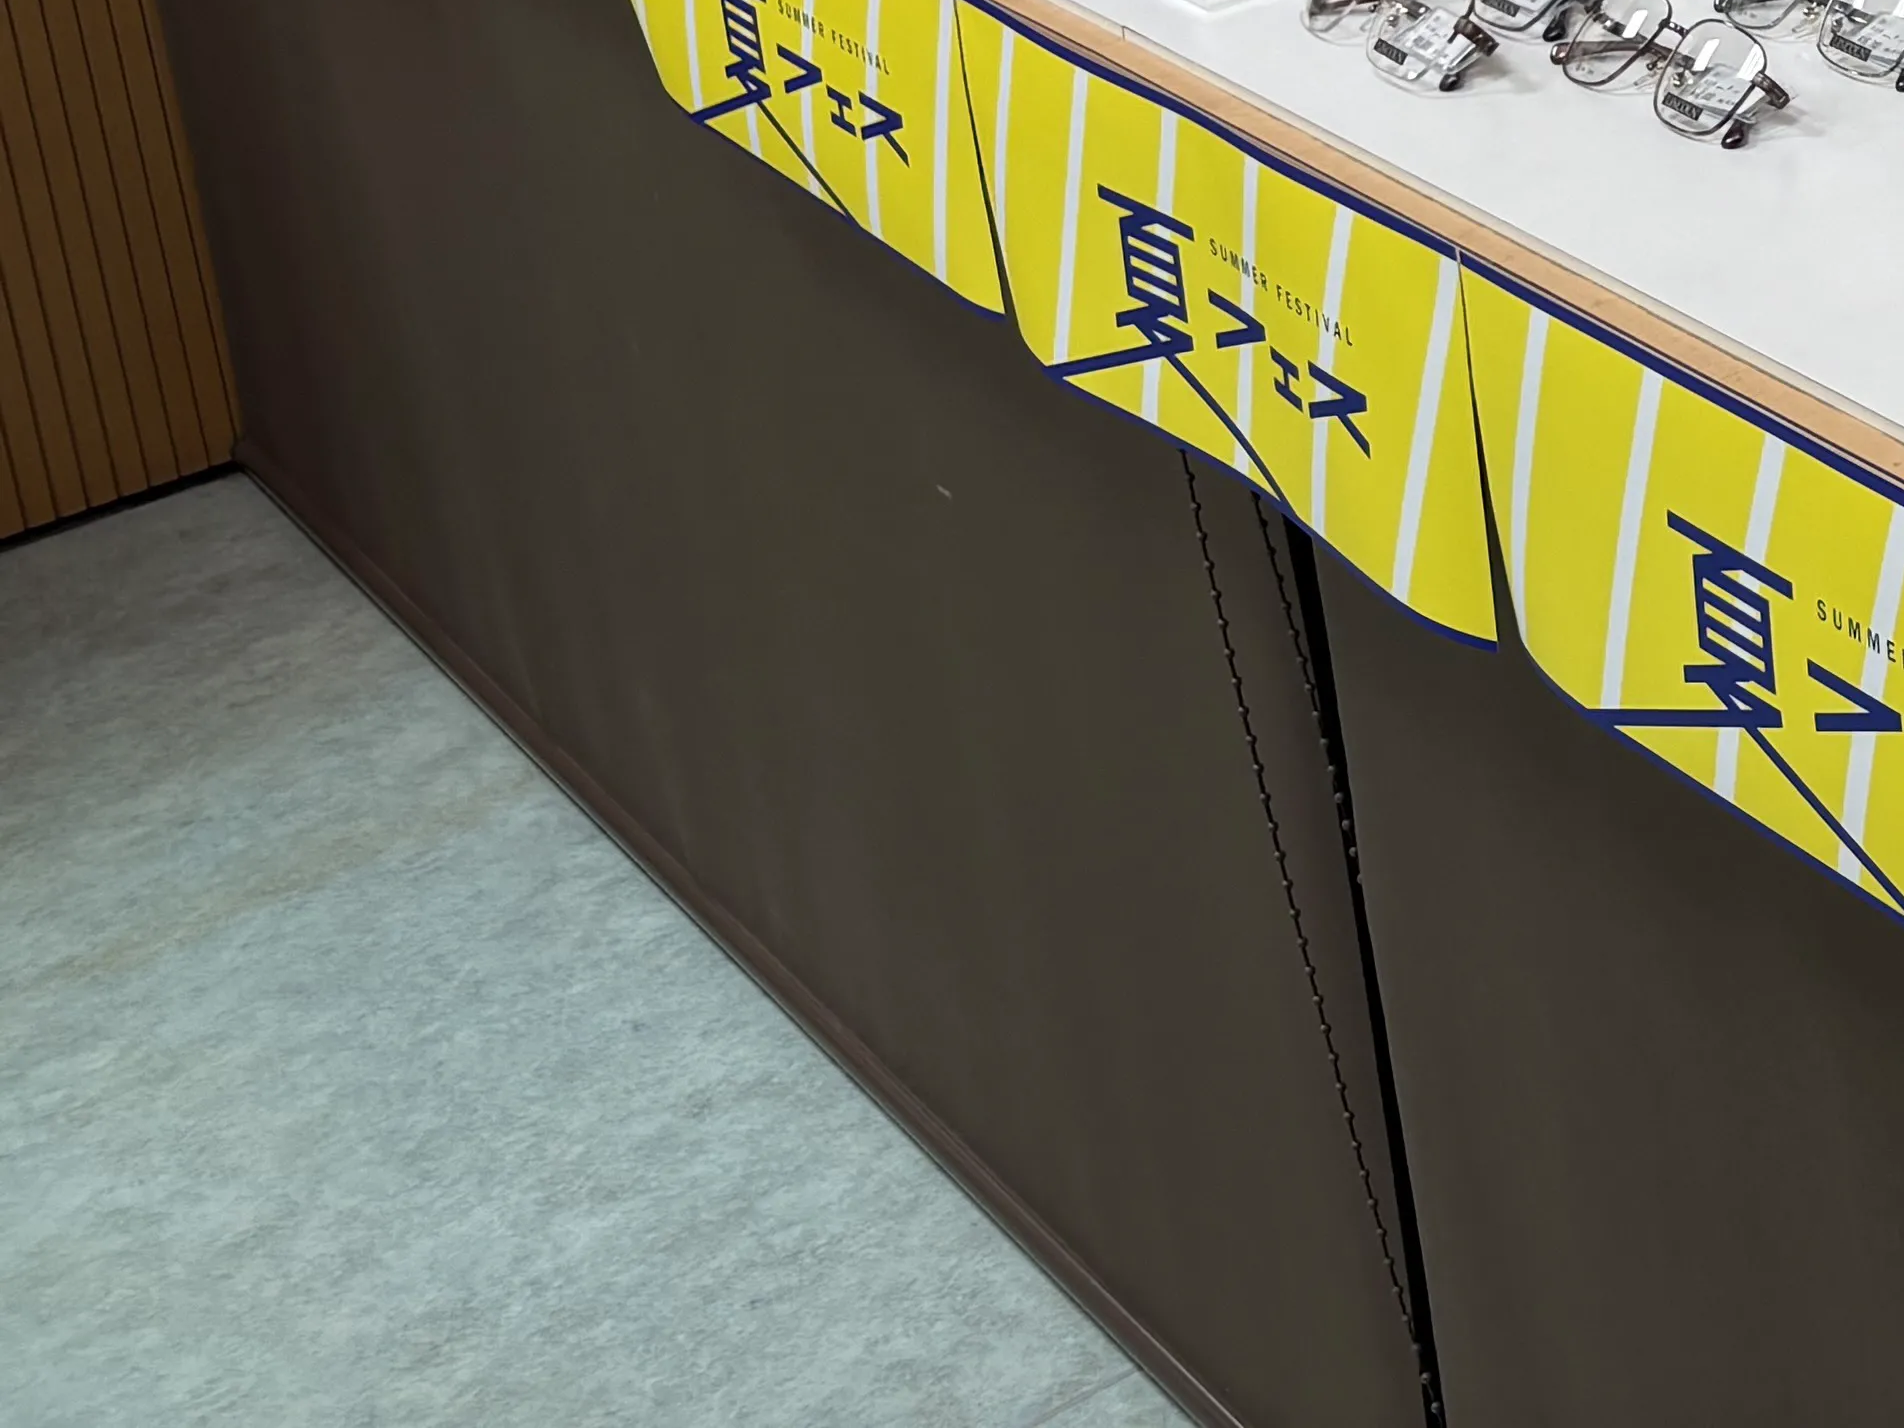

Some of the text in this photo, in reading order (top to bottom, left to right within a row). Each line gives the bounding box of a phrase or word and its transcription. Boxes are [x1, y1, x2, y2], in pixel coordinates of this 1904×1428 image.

[831, 27, 890, 77] FESTIVAL
[1208, 237, 1354, 348] SUMMER FESTIVAL
[1045, 183, 1371, 514] 夏フェス
